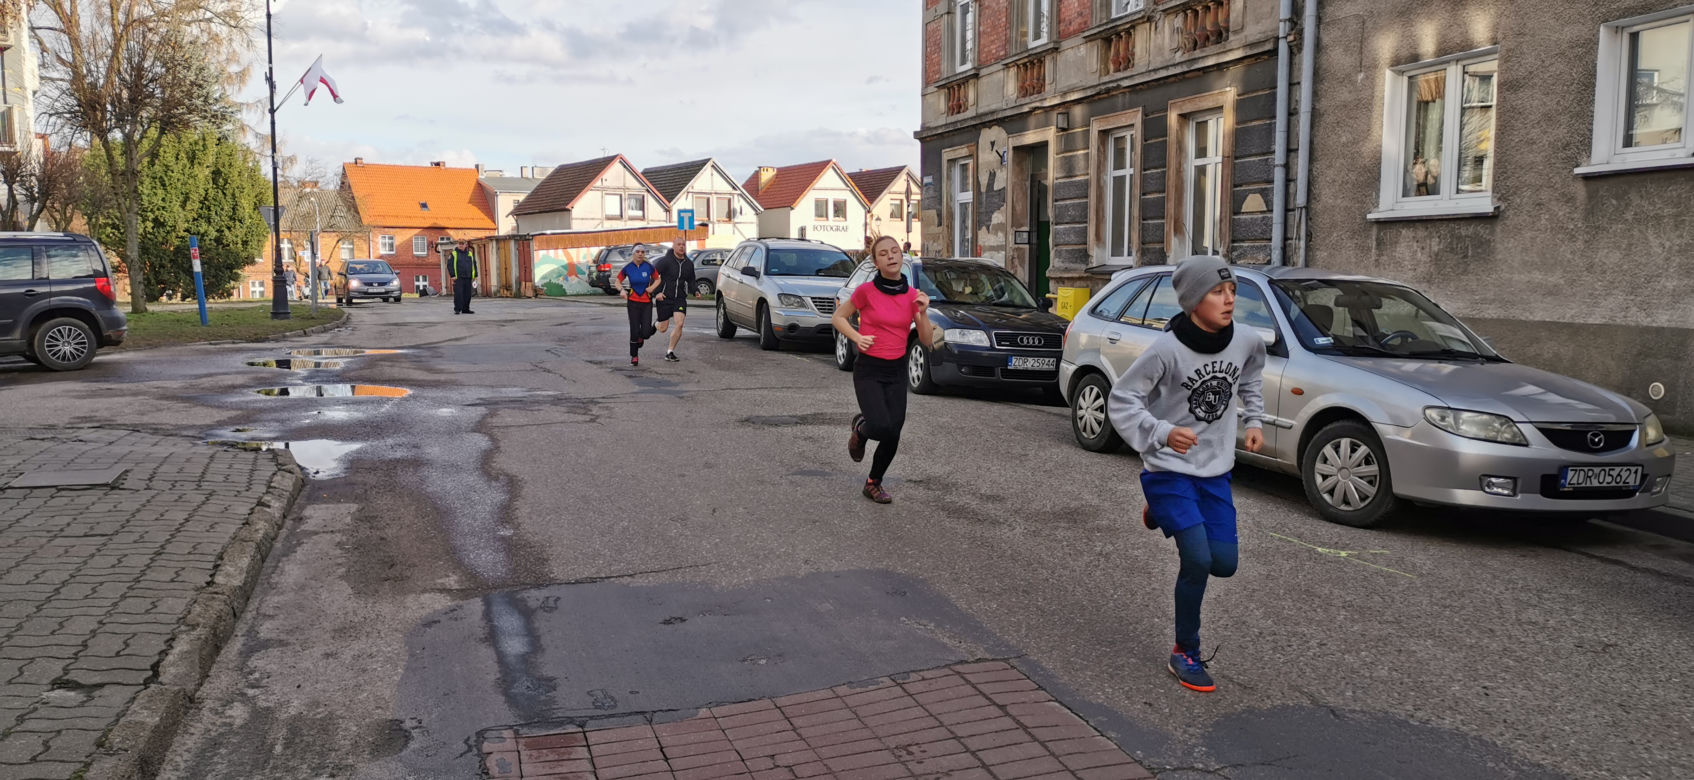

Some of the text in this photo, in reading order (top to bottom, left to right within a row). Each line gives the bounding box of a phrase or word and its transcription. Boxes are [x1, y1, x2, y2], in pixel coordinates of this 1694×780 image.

[1181, 360, 1240, 391] BARCELONA
[1567, 467, 1640, 486] ZDR 05621
